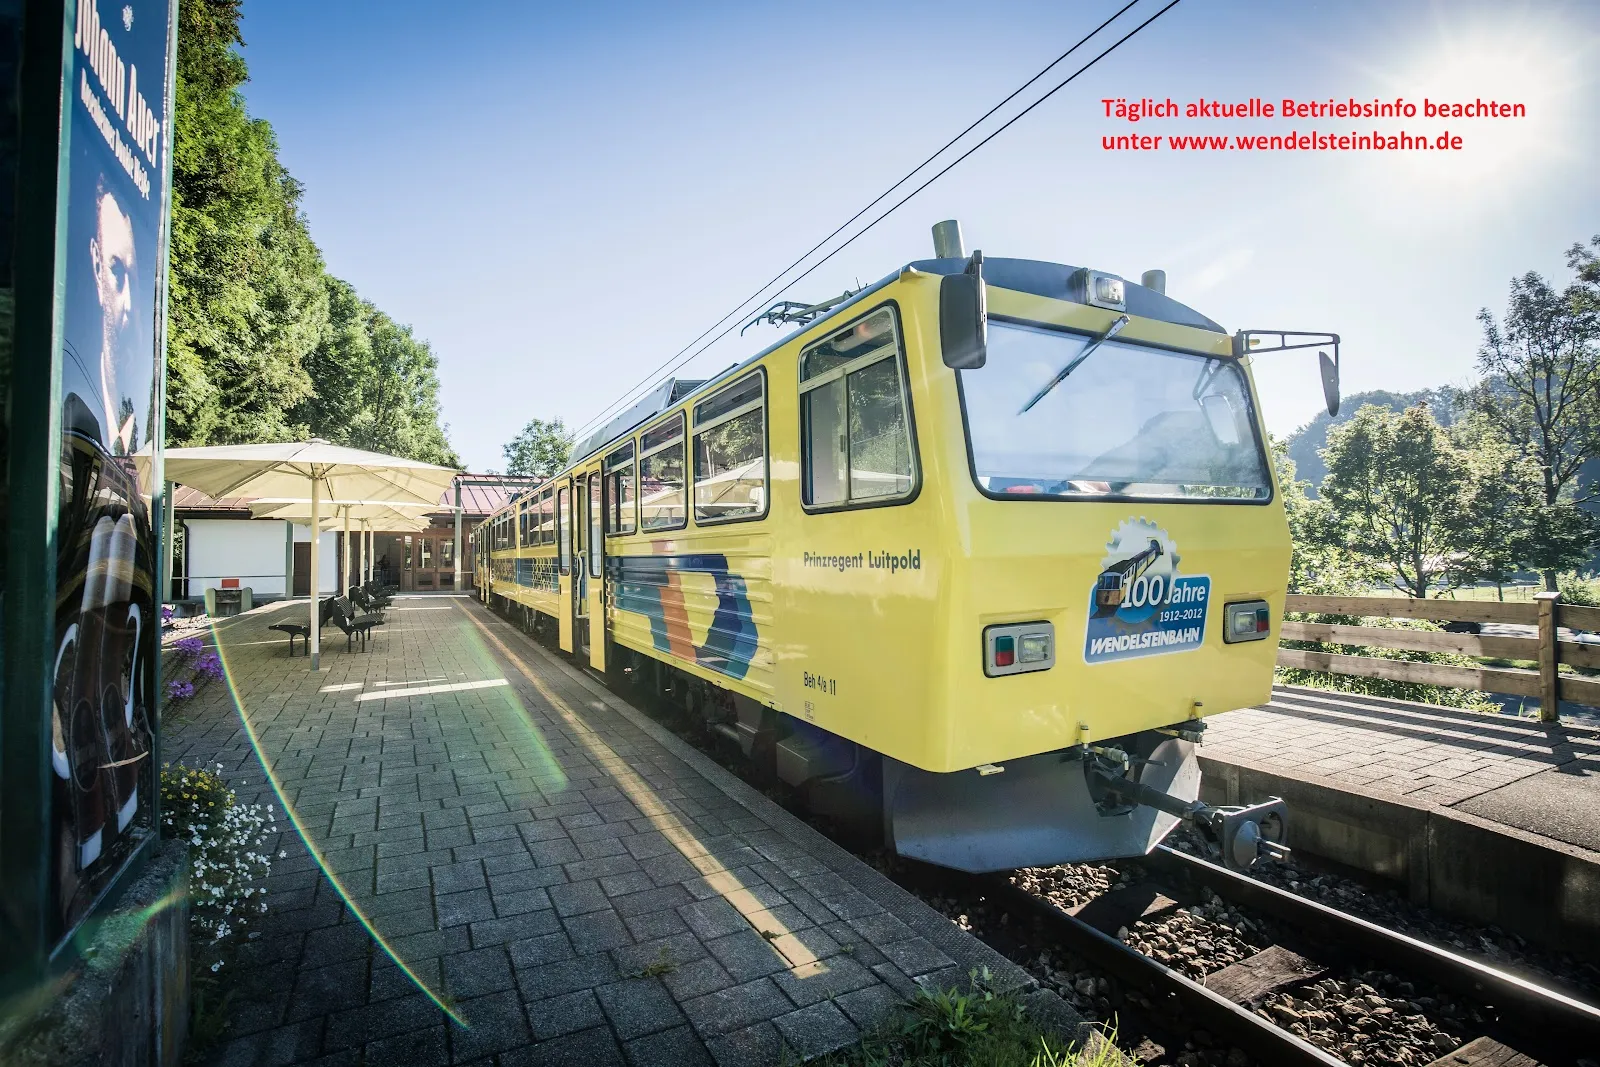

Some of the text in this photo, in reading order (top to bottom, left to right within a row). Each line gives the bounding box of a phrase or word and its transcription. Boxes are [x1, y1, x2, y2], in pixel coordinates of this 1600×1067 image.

[127, 63, 160, 168] Auer
[804, 549, 921, 574] Prinzregent Luitpold
[1121, 575, 1206, 609] 100 Jahre
[1090, 626, 1200, 655] WENDELSTEINBAHN
[803, 671, 816, 690] Beh
[829, 678, 836, 696] 11
